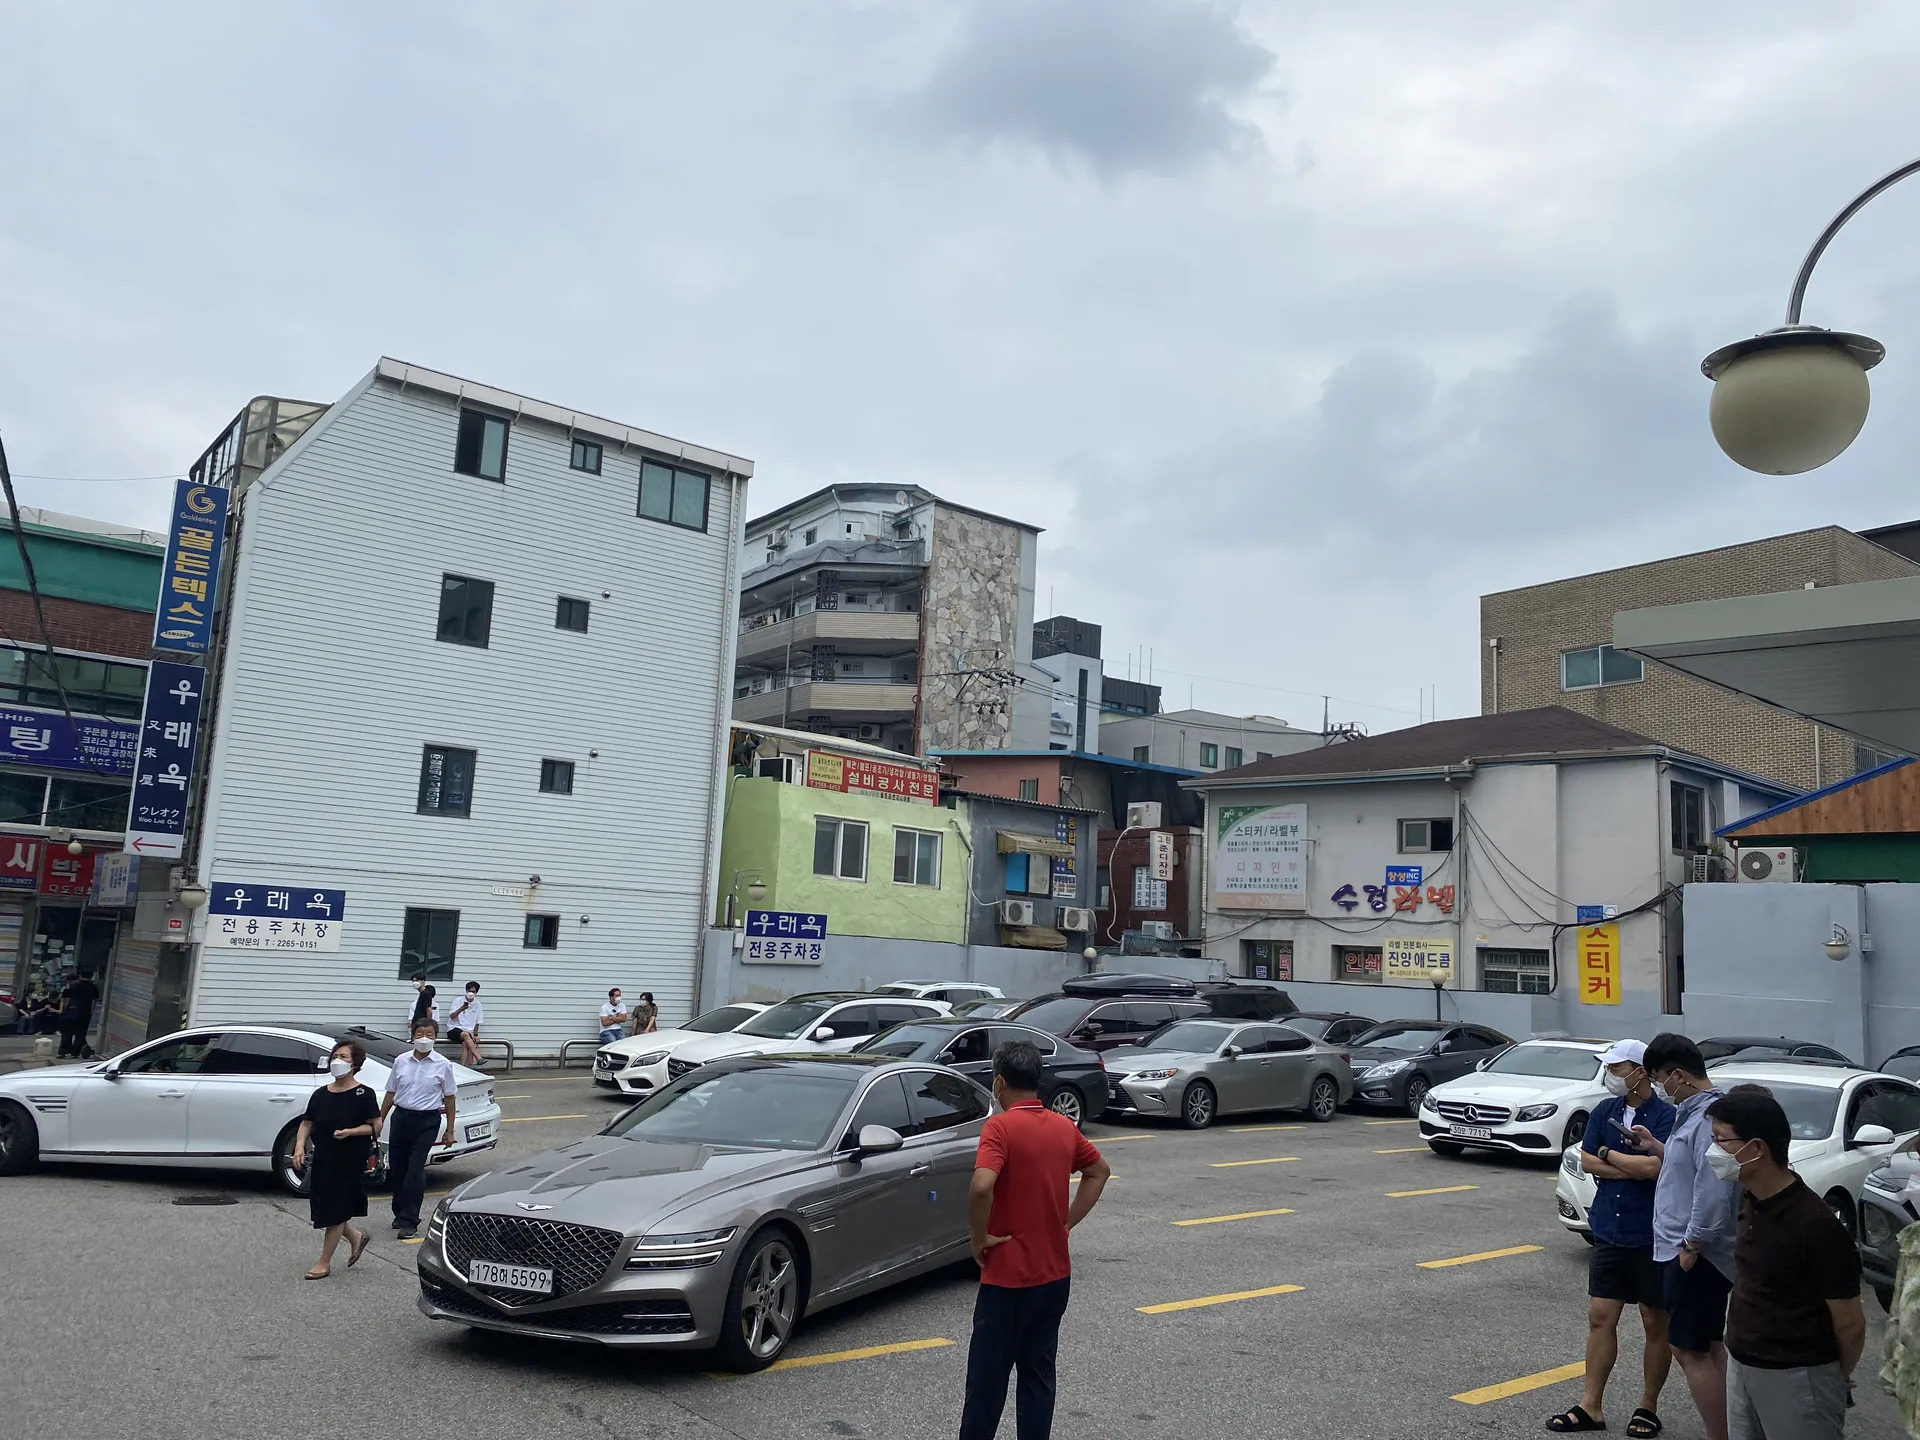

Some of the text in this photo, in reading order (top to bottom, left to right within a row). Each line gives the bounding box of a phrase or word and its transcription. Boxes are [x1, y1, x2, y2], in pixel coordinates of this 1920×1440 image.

[180, 512, 217, 525] Goldentex
[167, 526, 214, 625] 골든텍스
[9, 726, 51, 751] 팅
[158, 679, 198, 791] 우래옥
[139, 720, 162, 786] 又來屋
[848, 771, 934, 797] 설비공사전문
[139, 806, 180, 818] ウレオク
[6, 842, 36, 872] 시
[1237, 861, 1298, 874] 디자인부
[51, 860, 82, 882] 박
[225, 889, 331, 916] 우래옥
[222, 918, 329, 938] 전용주차장
[752, 913, 821, 937] 우래옥
[230, 937, 260, 947] 예약문의
[277, 939, 318, 948] 2265-0151
[749, 941, 821, 960] 전용주차장
[1586, 927, 1611, 999] 스티커
